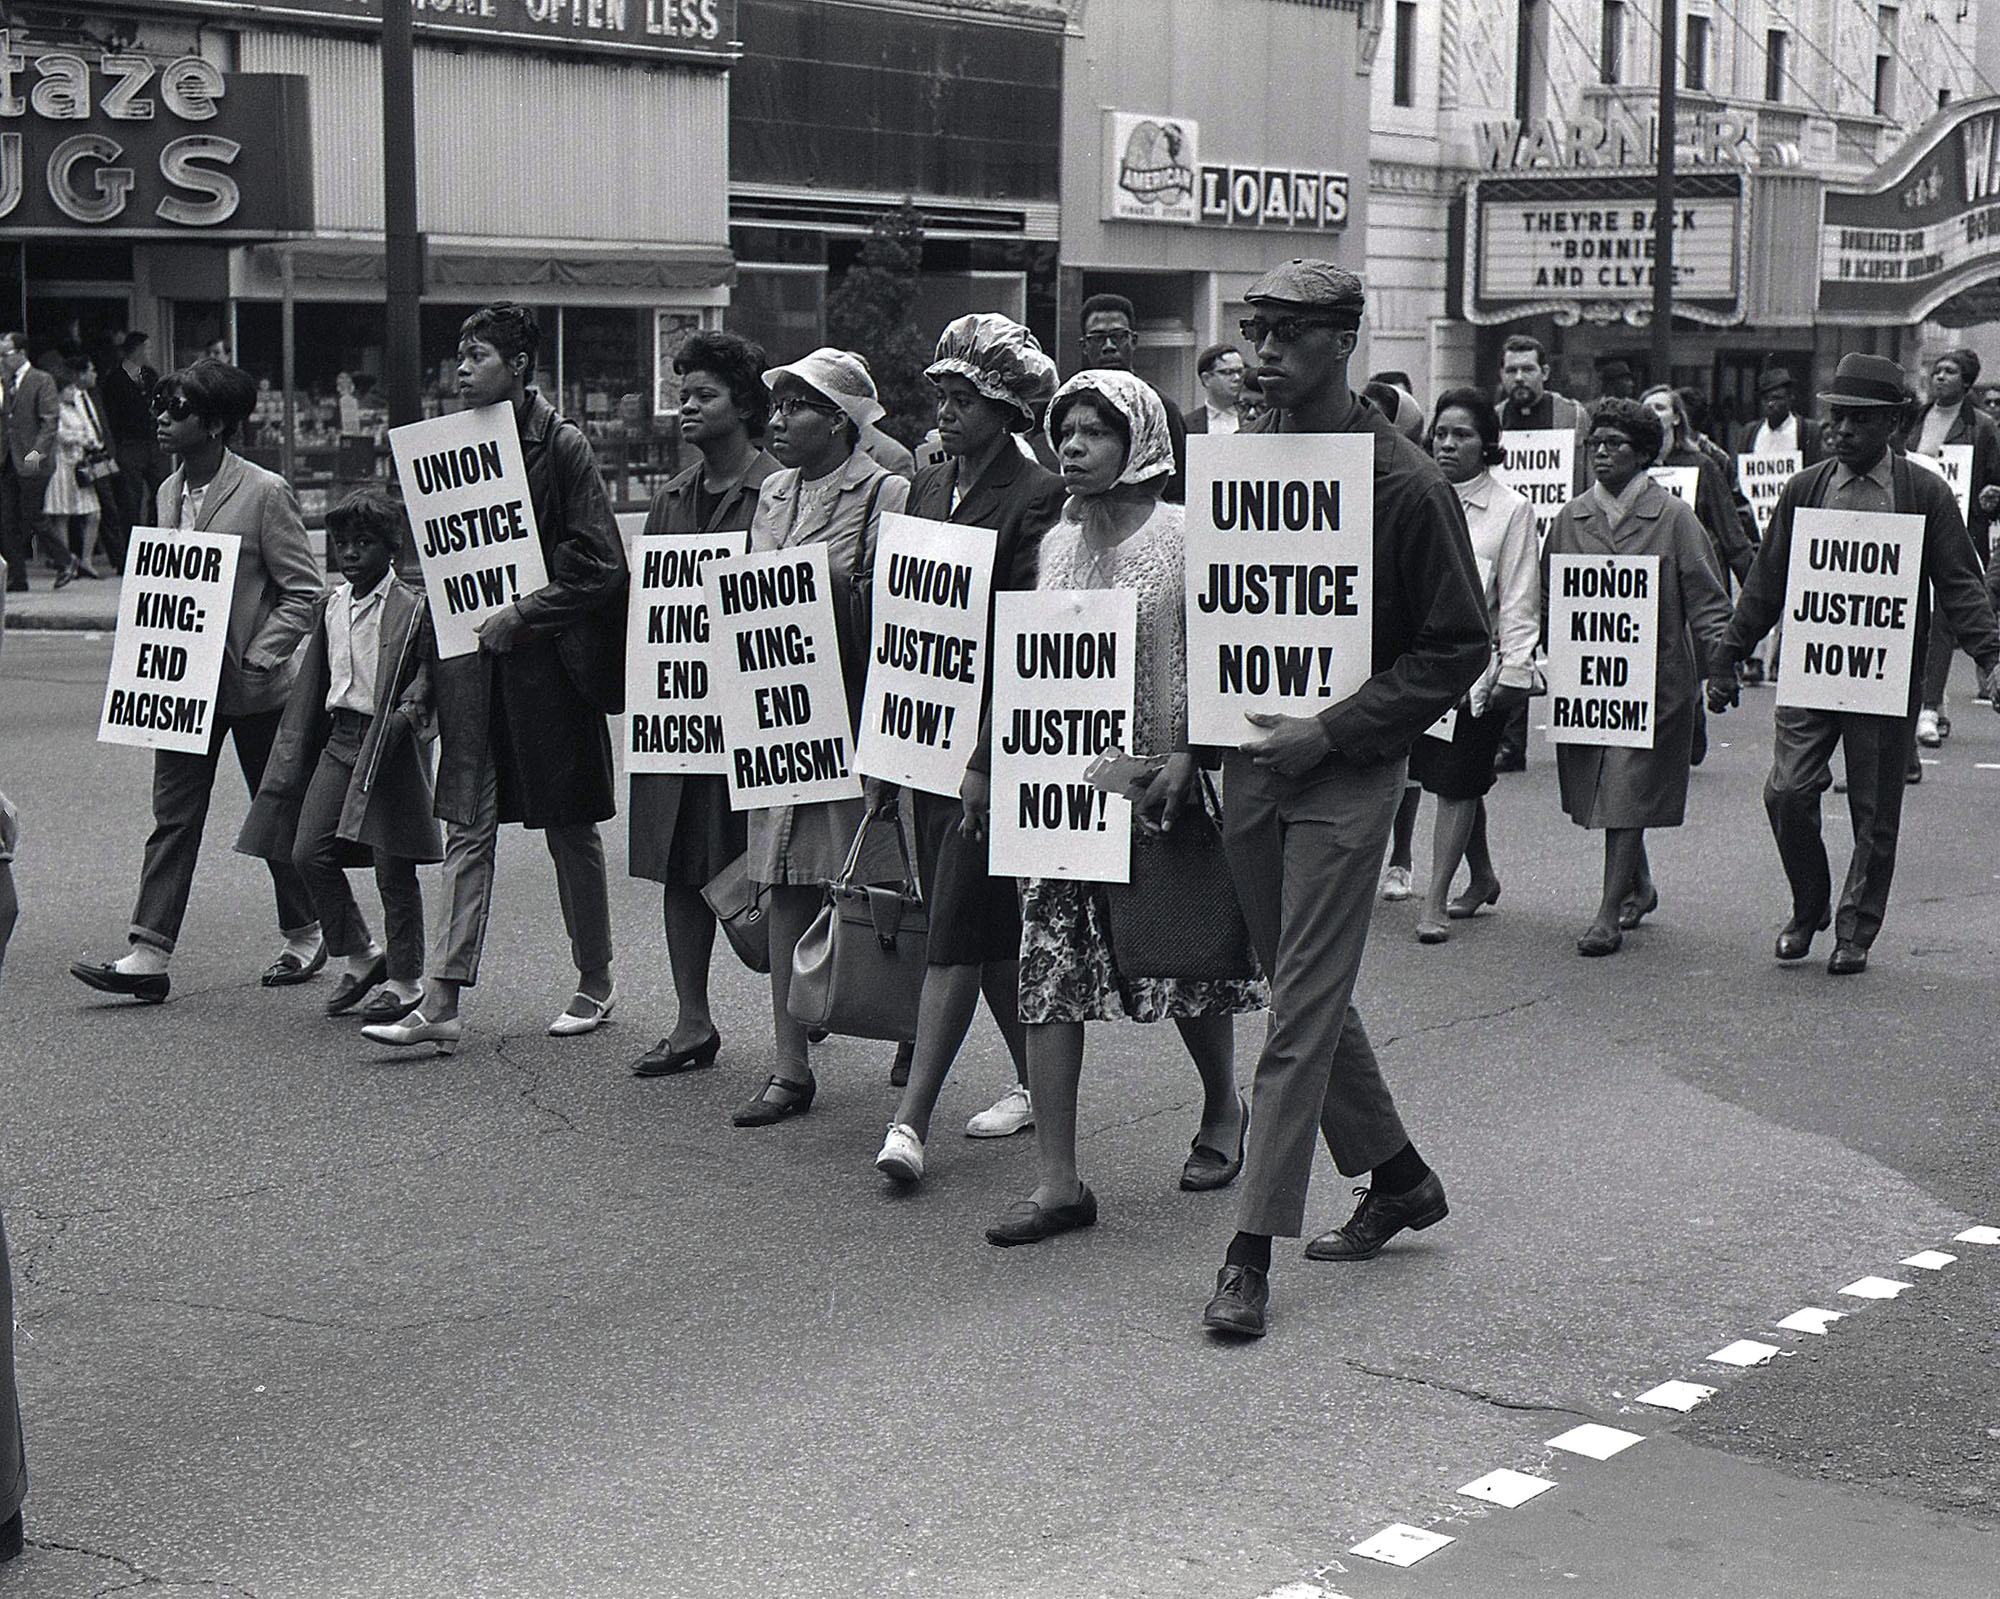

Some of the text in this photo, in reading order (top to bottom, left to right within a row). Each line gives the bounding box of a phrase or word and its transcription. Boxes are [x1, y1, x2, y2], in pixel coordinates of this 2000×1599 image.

[646, 0, 719, 40] LESS
[1476, 112, 1752, 171] WARNER
[1202, 172, 1348, 221] LOANS
[1522, 211, 1620, 233] THEY'RE
[1550, 239, 1658, 259] "BONNIE
[1535, 266, 1584, 287] AND
[413, 441, 503, 494] UNION
[1504, 449, 1561, 471] UNION
[1746, 459, 1795, 476] HONOR
[1213, 481, 1339, 531] UNION
[1508, 483, 1566, 505] STICE
[424, 501, 528, 557] JUSTICE
[136, 542, 222, 582] HONOR
[643, 548, 731, 589] HONO
[1810, 539, 1900, 575] UNION
[444, 564, 521, 615] NOW!
[719, 562, 817, 615] HONOR
[889, 553, 972, 610] UNION
[1198, 564, 1358, 616] JUSTICE
[1563, 567, 1648, 598] HONOR
[136, 592, 205, 633] KING:
[1571, 611, 1640, 643] KING:
[1793, 591, 1908, 630] JUSTICE
[137, 644, 188, 682] END
[737, 624, 816, 672] KING:
[877, 623, 977, 684] JUSTICE
[1016, 632, 1116, 679] UNION
[1804, 643, 1887, 680] NOW!
[657, 661, 708, 699] END
[1220, 645, 1333, 697] NOW!
[1581, 656, 1628, 687] END
[108, 690, 207, 735] RACISM!
[755, 684, 811, 730] END
[881, 692, 956, 750] NOW!
[1554, 697, 1648, 732] RACISM!
[1003, 709, 1125, 755] JUSTICE
[734, 737, 849, 789] RACISM!
[1019, 783, 1108, 832] NOW!
